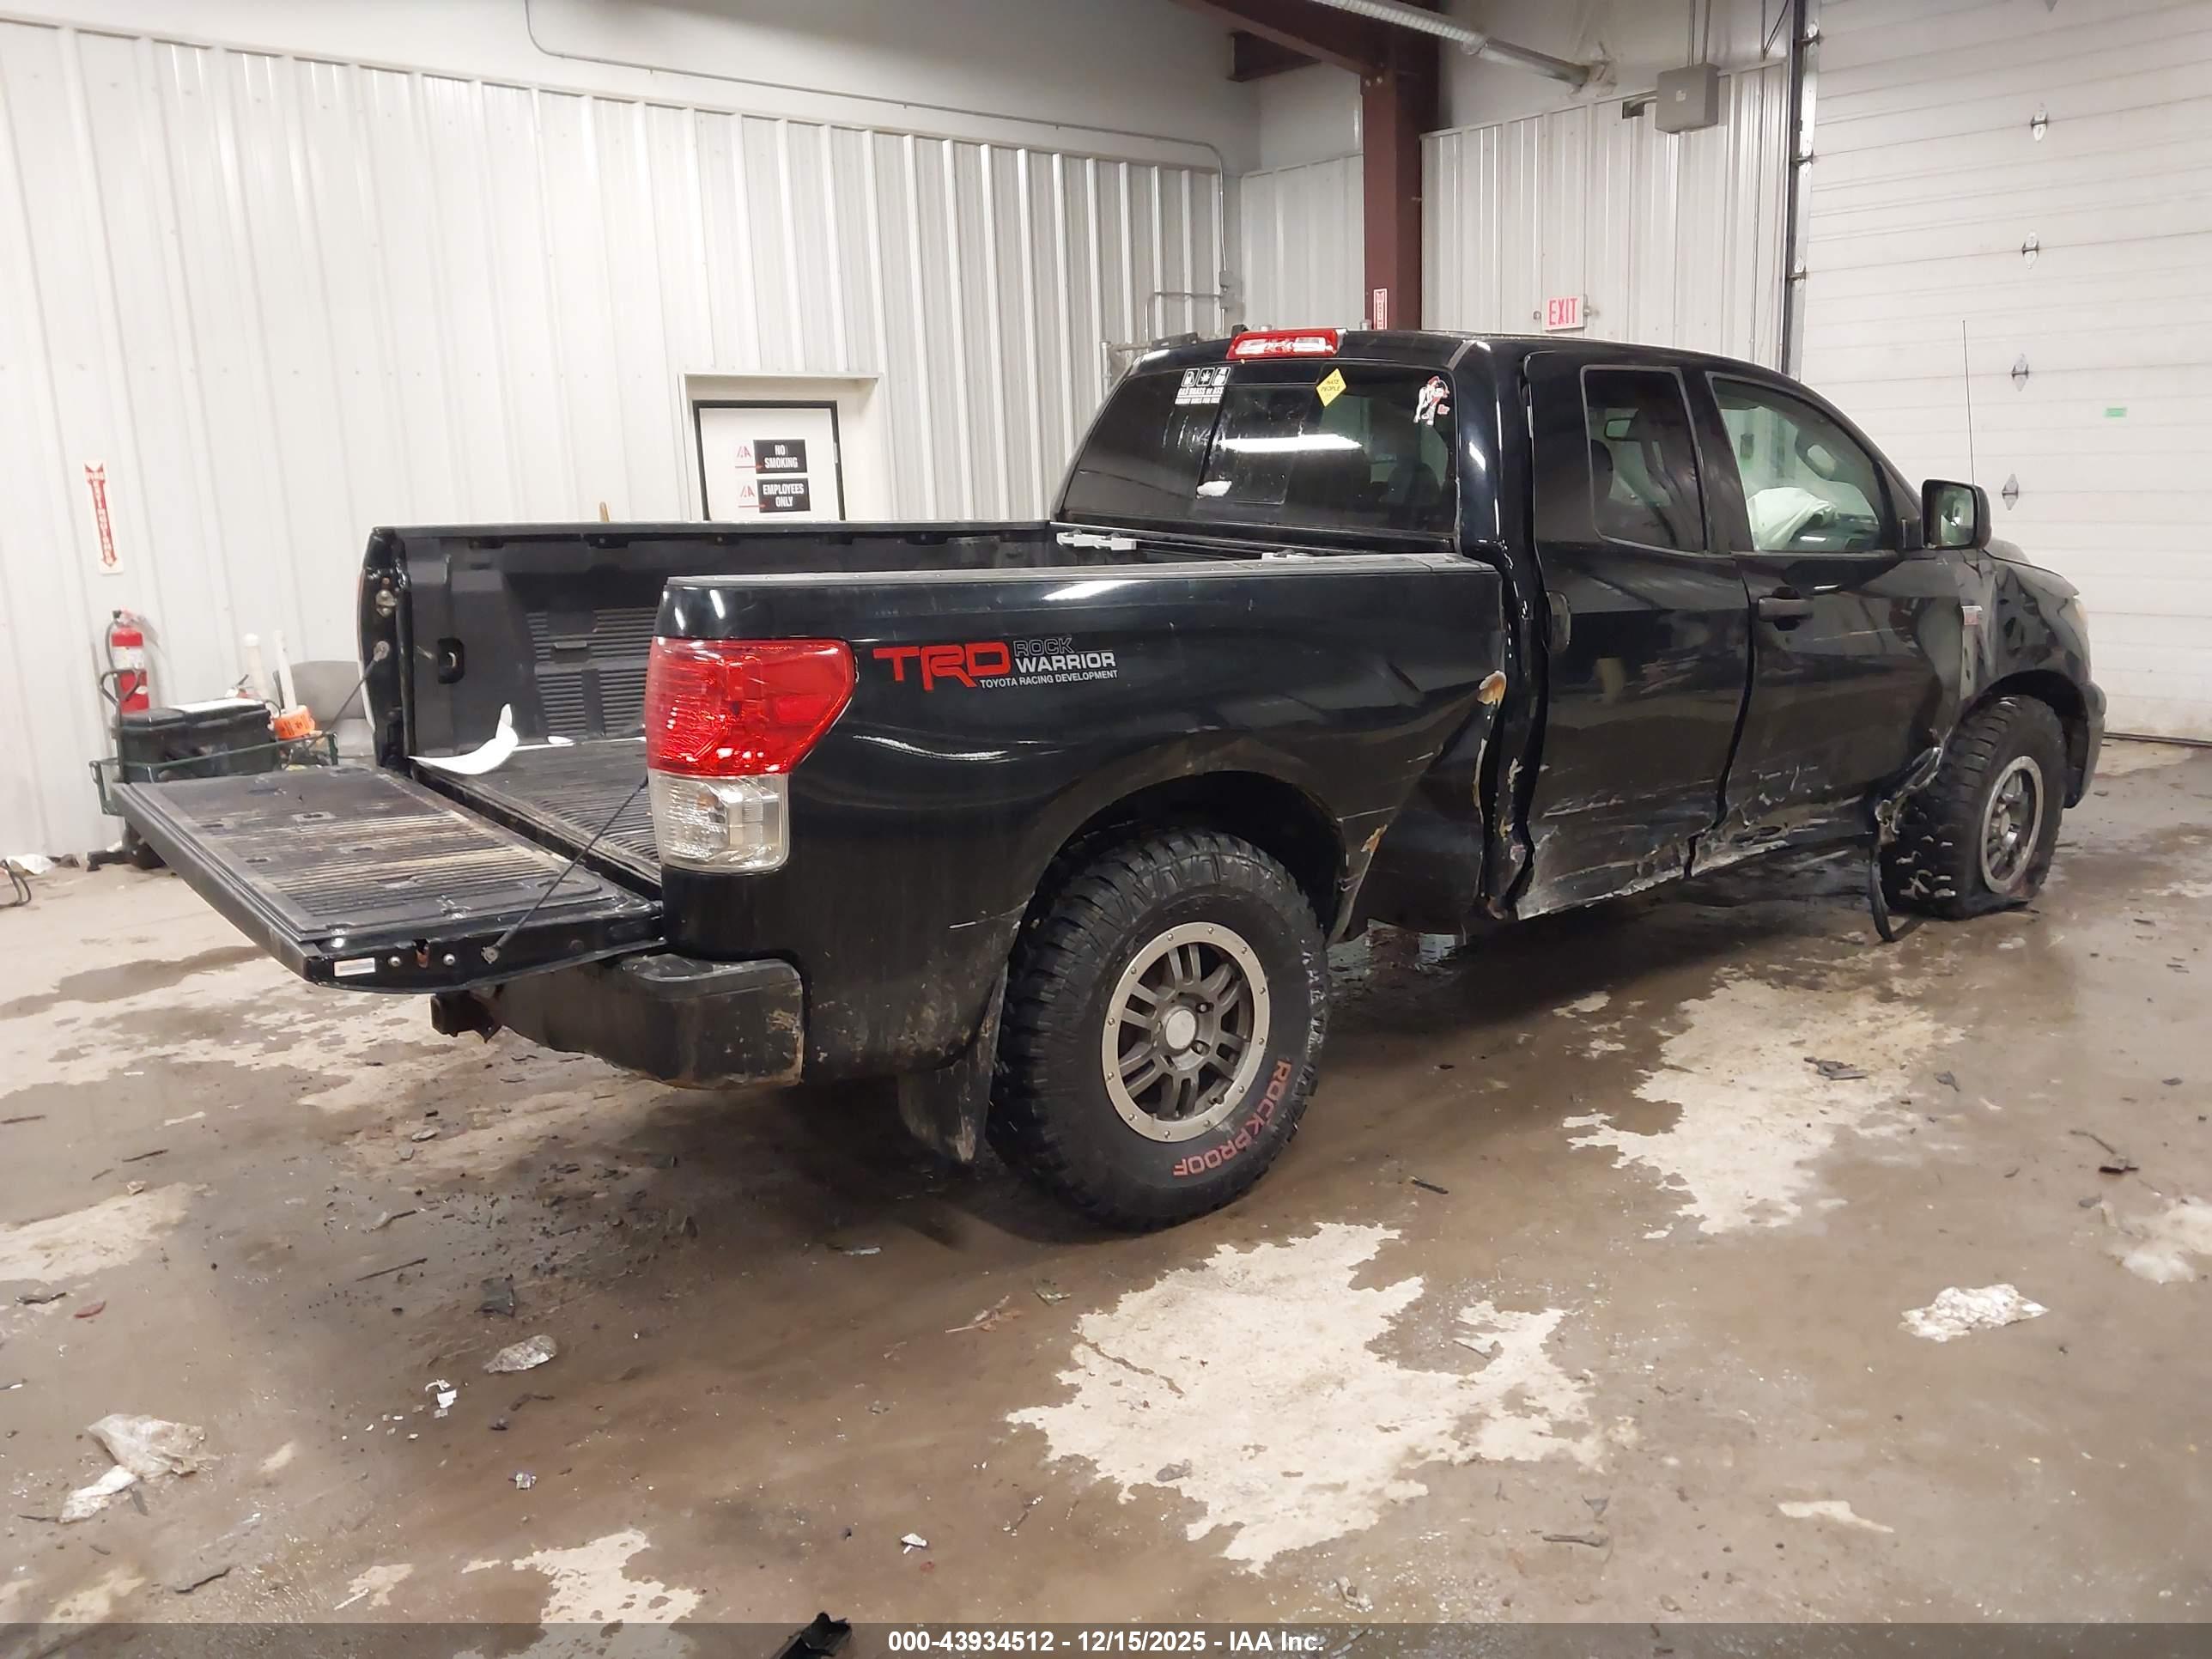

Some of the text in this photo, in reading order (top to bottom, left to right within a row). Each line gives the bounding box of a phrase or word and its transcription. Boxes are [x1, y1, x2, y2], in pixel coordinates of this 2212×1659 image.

[1548, 298, 1577, 325] EXIT
[775, 445, 785, 456] NO
[763, 457, 799, 469] SMOKING
[763, 483, 805, 495] EMPLOYEES
[775, 496, 793, 507] ONLY
[1012, 638, 1074, 657] ROCK
[872, 642, 1012, 691] TRD
[1015, 652, 1116, 673] WARRIOR
[980, 670, 1118, 689] TOYOTA RACING DEVELOPMENT
[1173, 1059, 1291, 1176] ROCKPROOF
